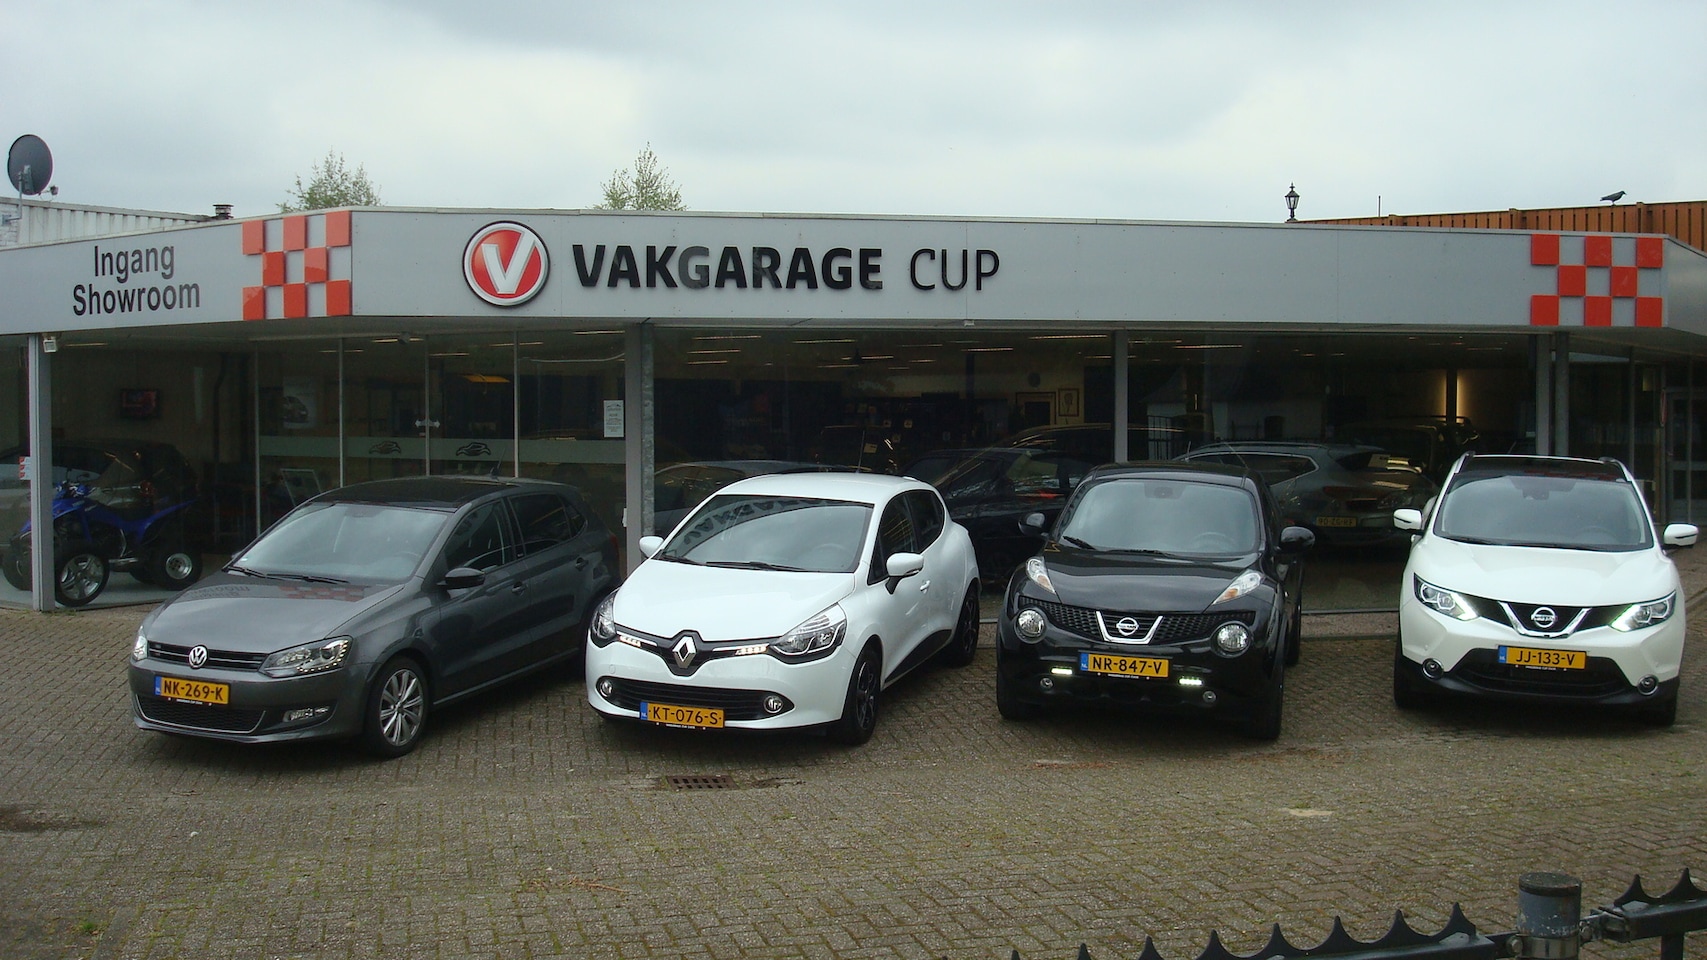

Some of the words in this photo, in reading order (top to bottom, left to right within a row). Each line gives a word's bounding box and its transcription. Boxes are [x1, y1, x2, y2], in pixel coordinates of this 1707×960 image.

[93, 244, 175, 284] Ingang
[572, 243, 883, 290] VAKGARAGE
[909, 248, 1000, 291] CUP
[72, 282, 201, 317] Showroom
[1092, 657, 1162, 674] NR-847-V
[1516, 650, 1575, 666] JJ-133-V
[164, 680, 223, 701] NK-269-K
[653, 706, 718, 725] KT-076-S
